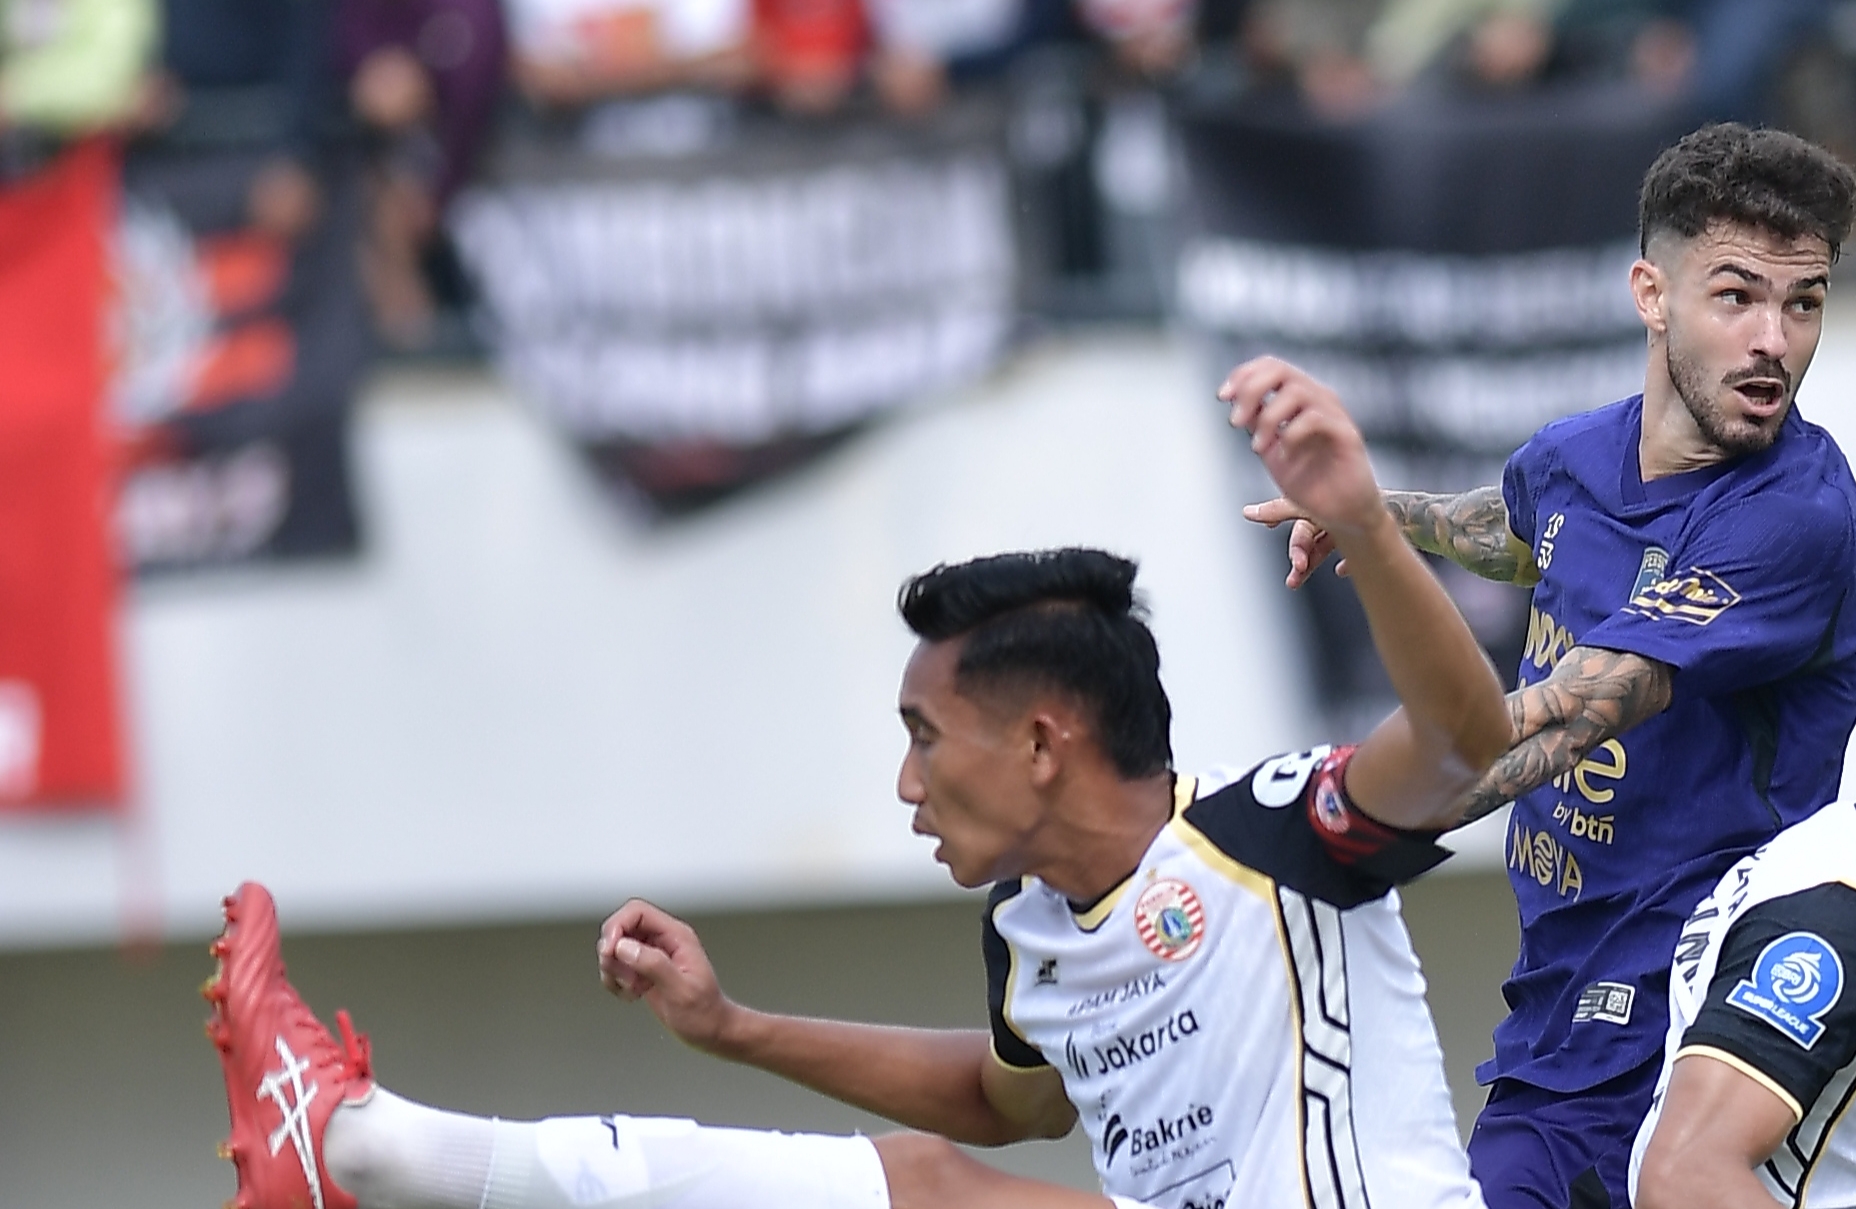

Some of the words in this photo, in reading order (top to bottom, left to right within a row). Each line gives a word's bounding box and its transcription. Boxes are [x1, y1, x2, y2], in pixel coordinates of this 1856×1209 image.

[1553, 801, 1572, 826] by
[1510, 821, 1582, 902] MOYA
[1094, 1009, 1200, 1075] Jakarta
[1772, 1004, 1810, 1035] LEAGUE
[1130, 1103, 1214, 1157] Bakrie
